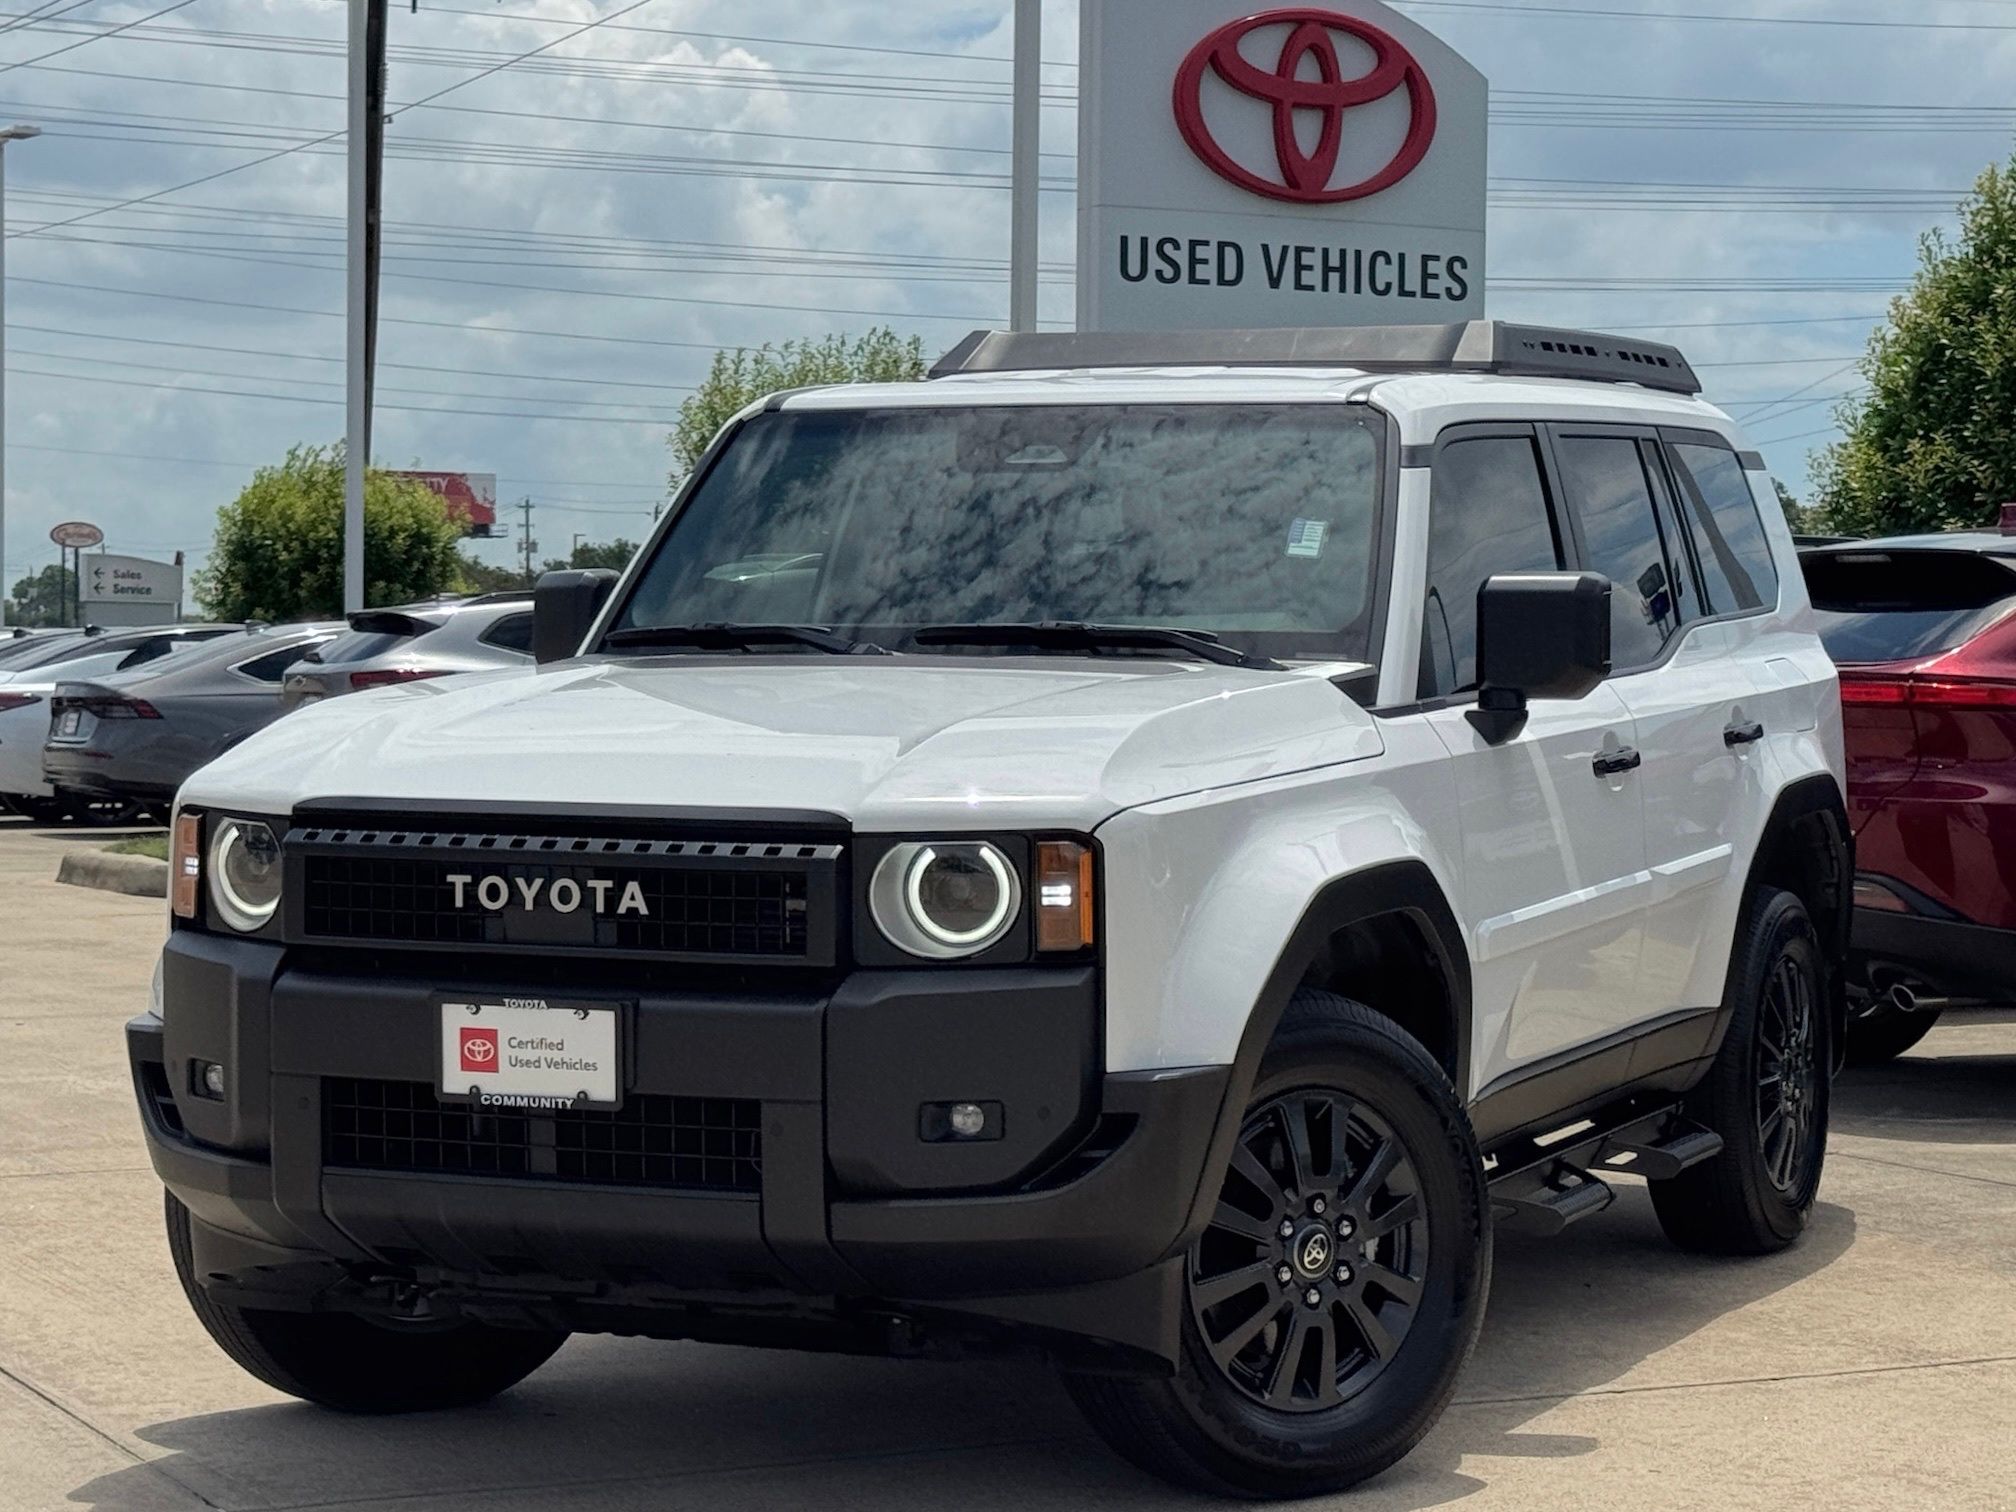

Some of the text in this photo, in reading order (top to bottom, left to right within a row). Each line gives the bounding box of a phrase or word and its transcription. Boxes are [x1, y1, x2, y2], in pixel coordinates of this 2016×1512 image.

[1119, 234, 1469, 303] USED VEHICLES
[113, 569, 142, 580] Sales
[112, 584, 152, 595] Service
[446, 874, 650, 916] TOYOTA
[502, 998, 549, 1010] TOYOTA
[507, 1036, 565, 1051] Certified
[508, 1055, 598, 1072] Used Vehicles
[480, 1094, 576, 1110] COMMUNITY
